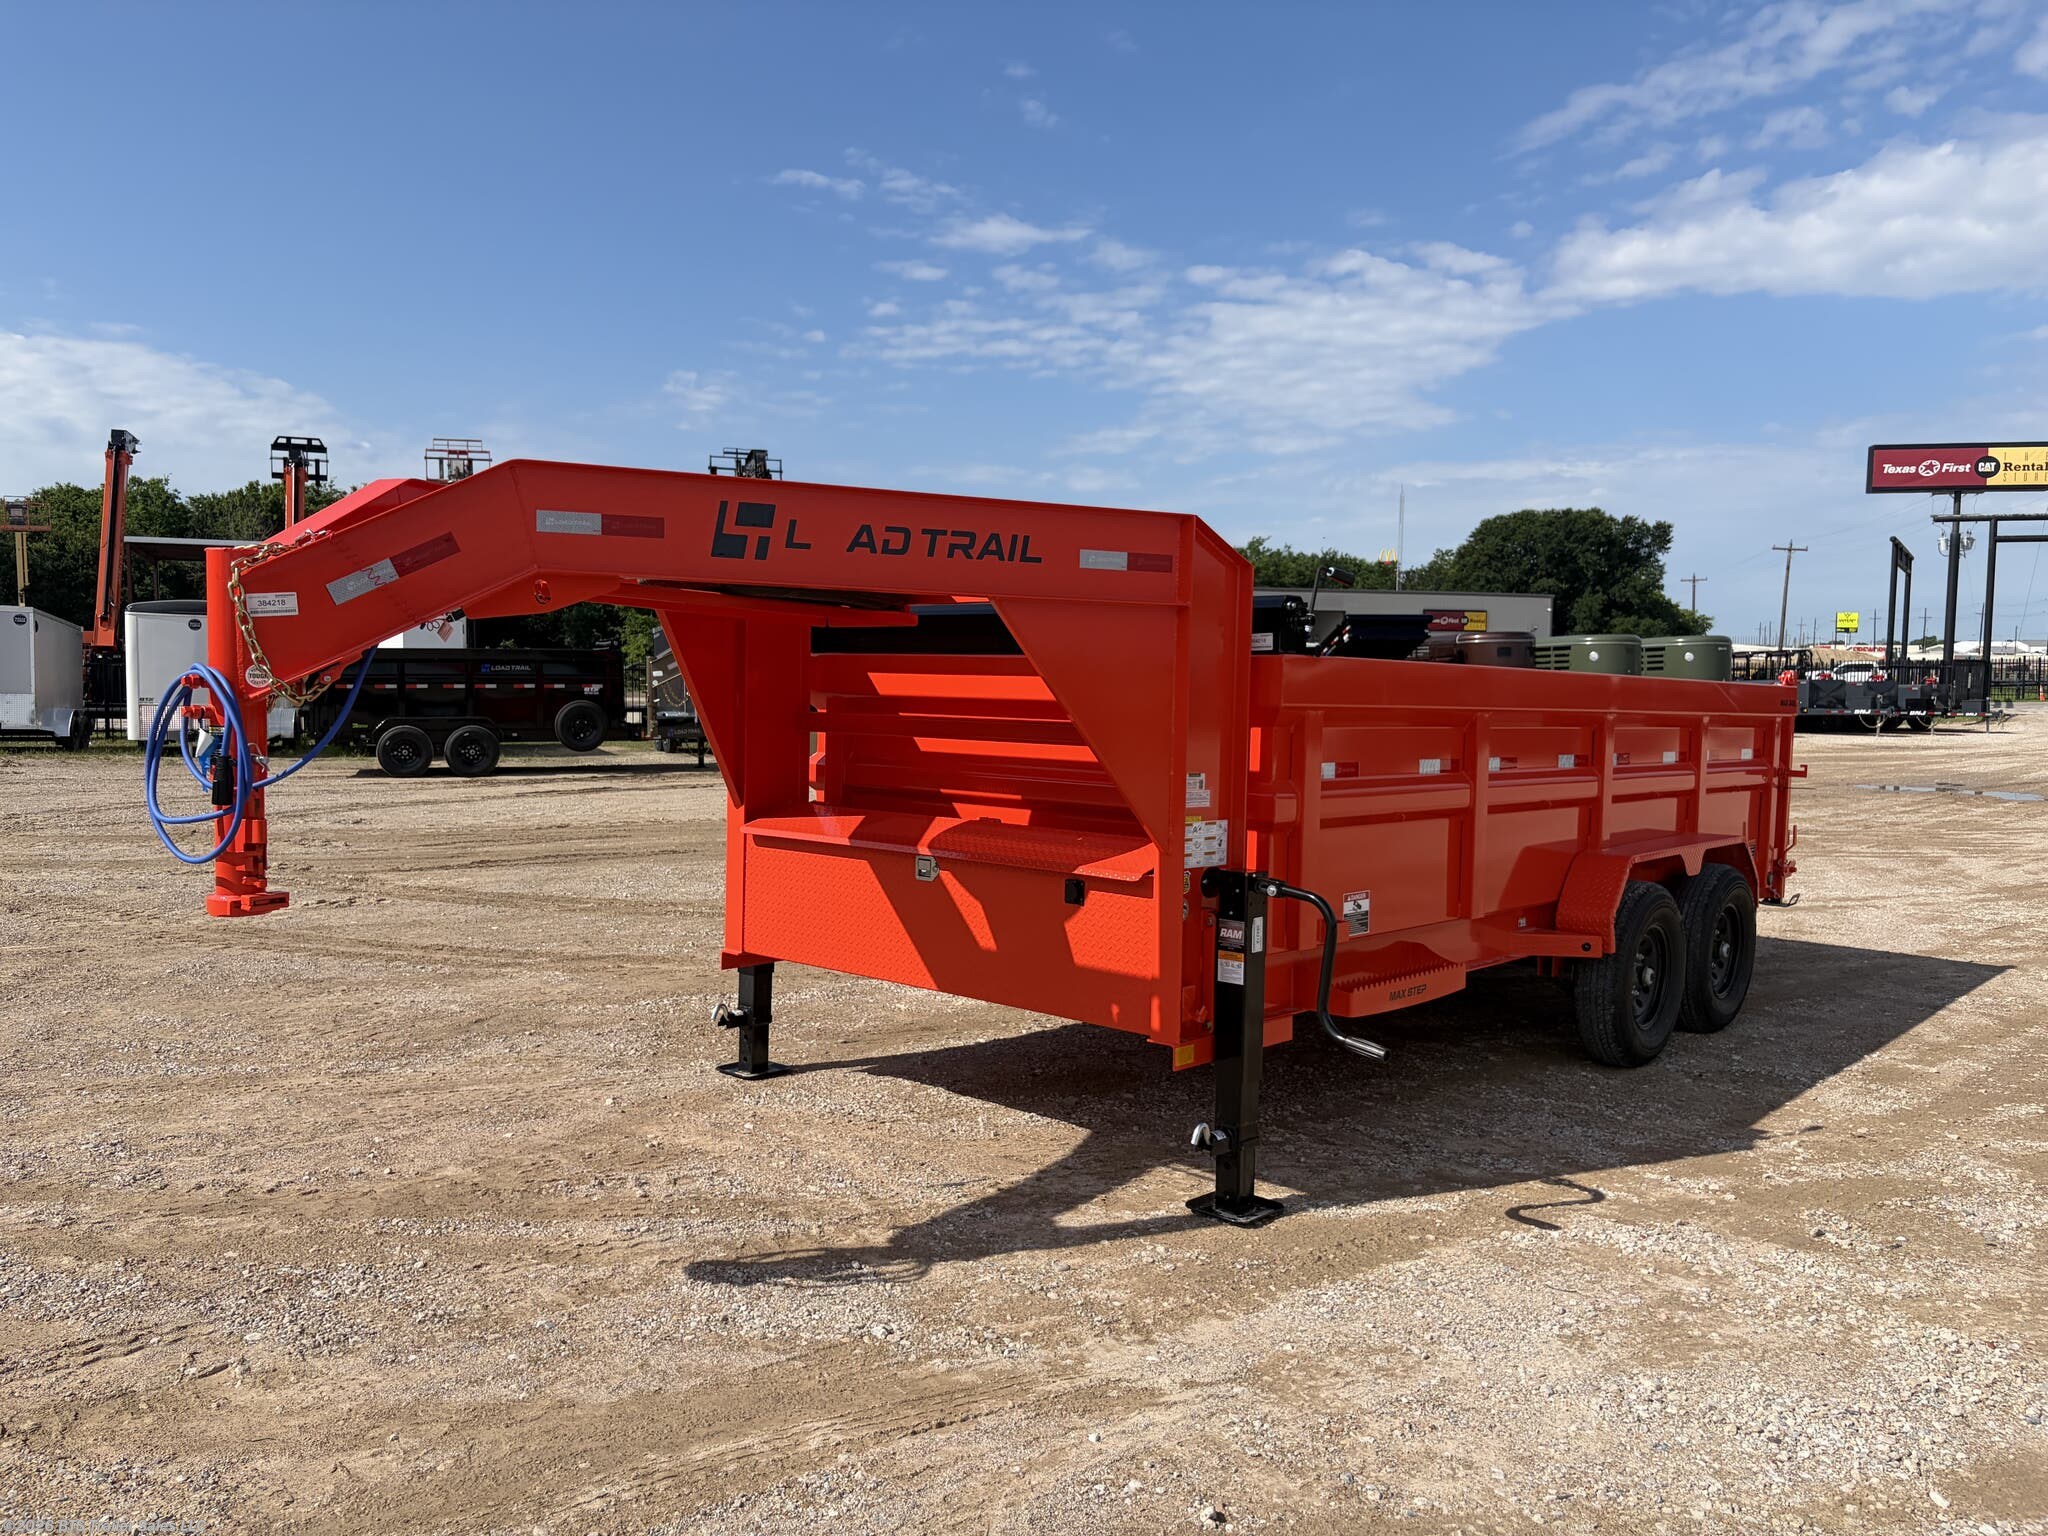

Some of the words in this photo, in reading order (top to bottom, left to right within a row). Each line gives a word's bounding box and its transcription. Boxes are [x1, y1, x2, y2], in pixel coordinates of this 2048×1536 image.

[1882, 463, 1916, 474] Texas
[1941, 463, 1971, 473] First
[1978, 462, 1996, 472] CAT
[2002, 462, 2048, 471] Rental
[257, 599, 286, 607] 384218
[1220, 928, 1243, 940] RAM
[1389, 989, 1406, 1001] MAX
[1407, 984, 1427, 997] STEP
